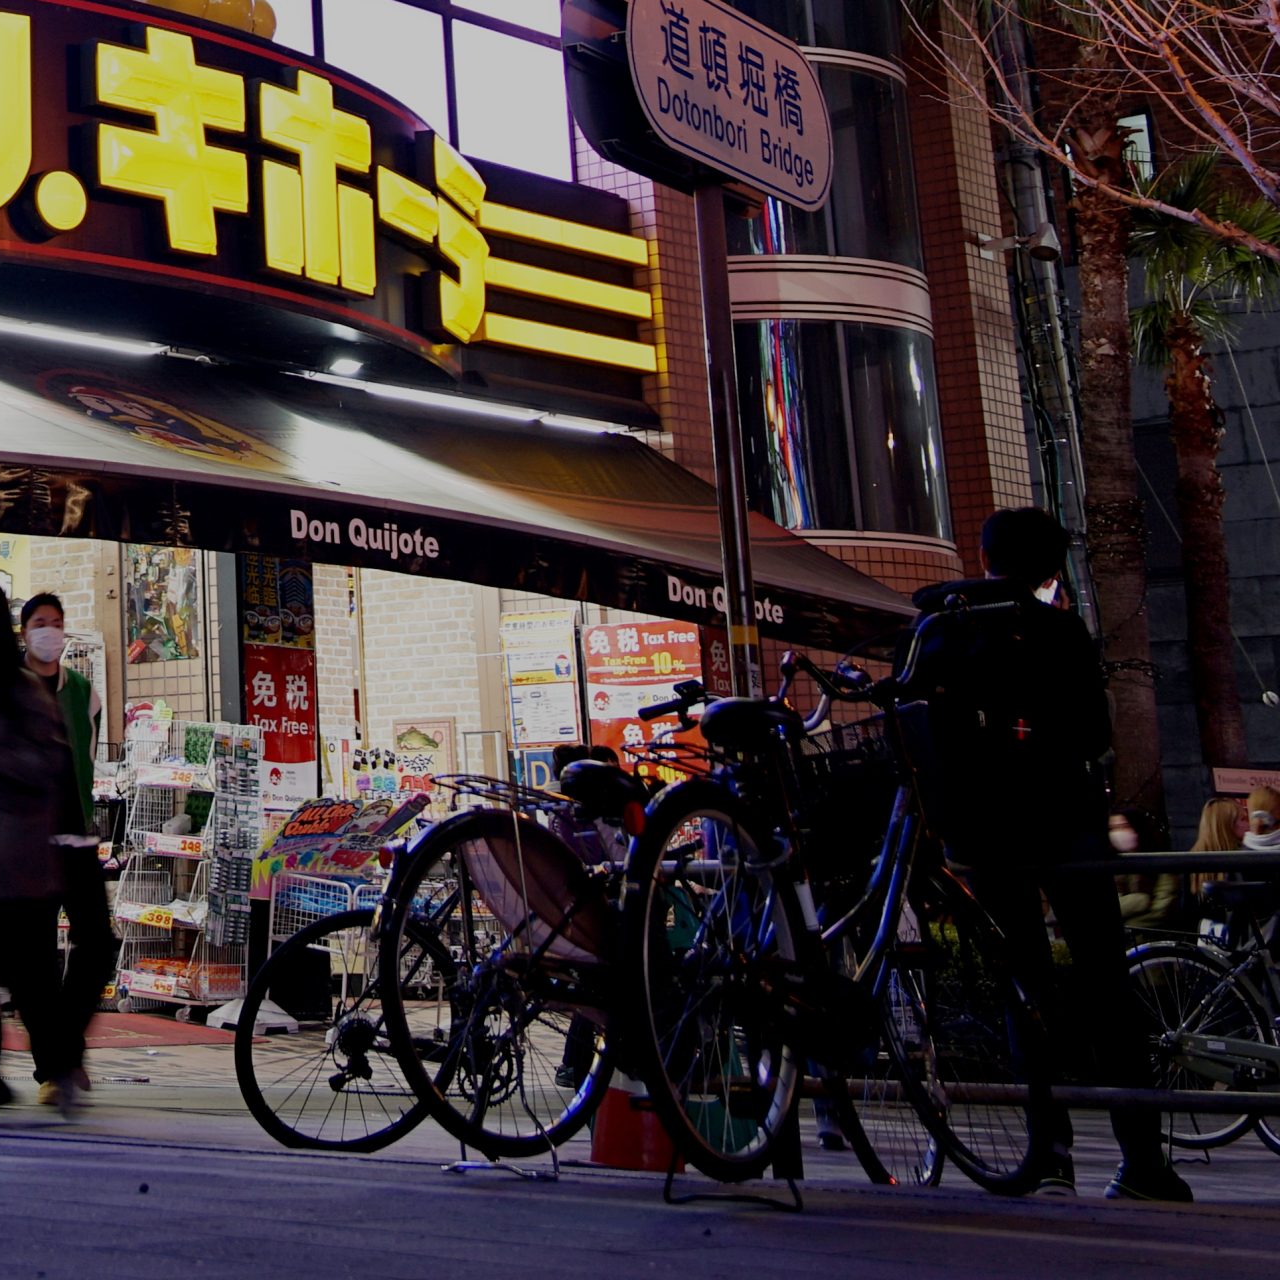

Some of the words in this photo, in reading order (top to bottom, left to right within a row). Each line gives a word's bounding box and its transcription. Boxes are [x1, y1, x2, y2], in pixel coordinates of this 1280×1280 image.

[660, 0, 803, 136] 道頓堀橋
[657, 76, 748, 153] Dotonbori
[760, 128, 813, 188] Bridge
[290, 509, 340, 544] Don
[348, 518, 439, 559] Quijote
[667, 575, 707, 608] Don
[712, 586, 784, 624] Qote
[588, 627, 640, 656] 免税
[642, 632, 665, 645] Tax
[667, 630, 696, 643] Free
[252, 670, 309, 710] 免税
[253, 714, 277, 733] Tax
[281, 717, 308, 735] Free
[147, 911, 171, 926] 398
